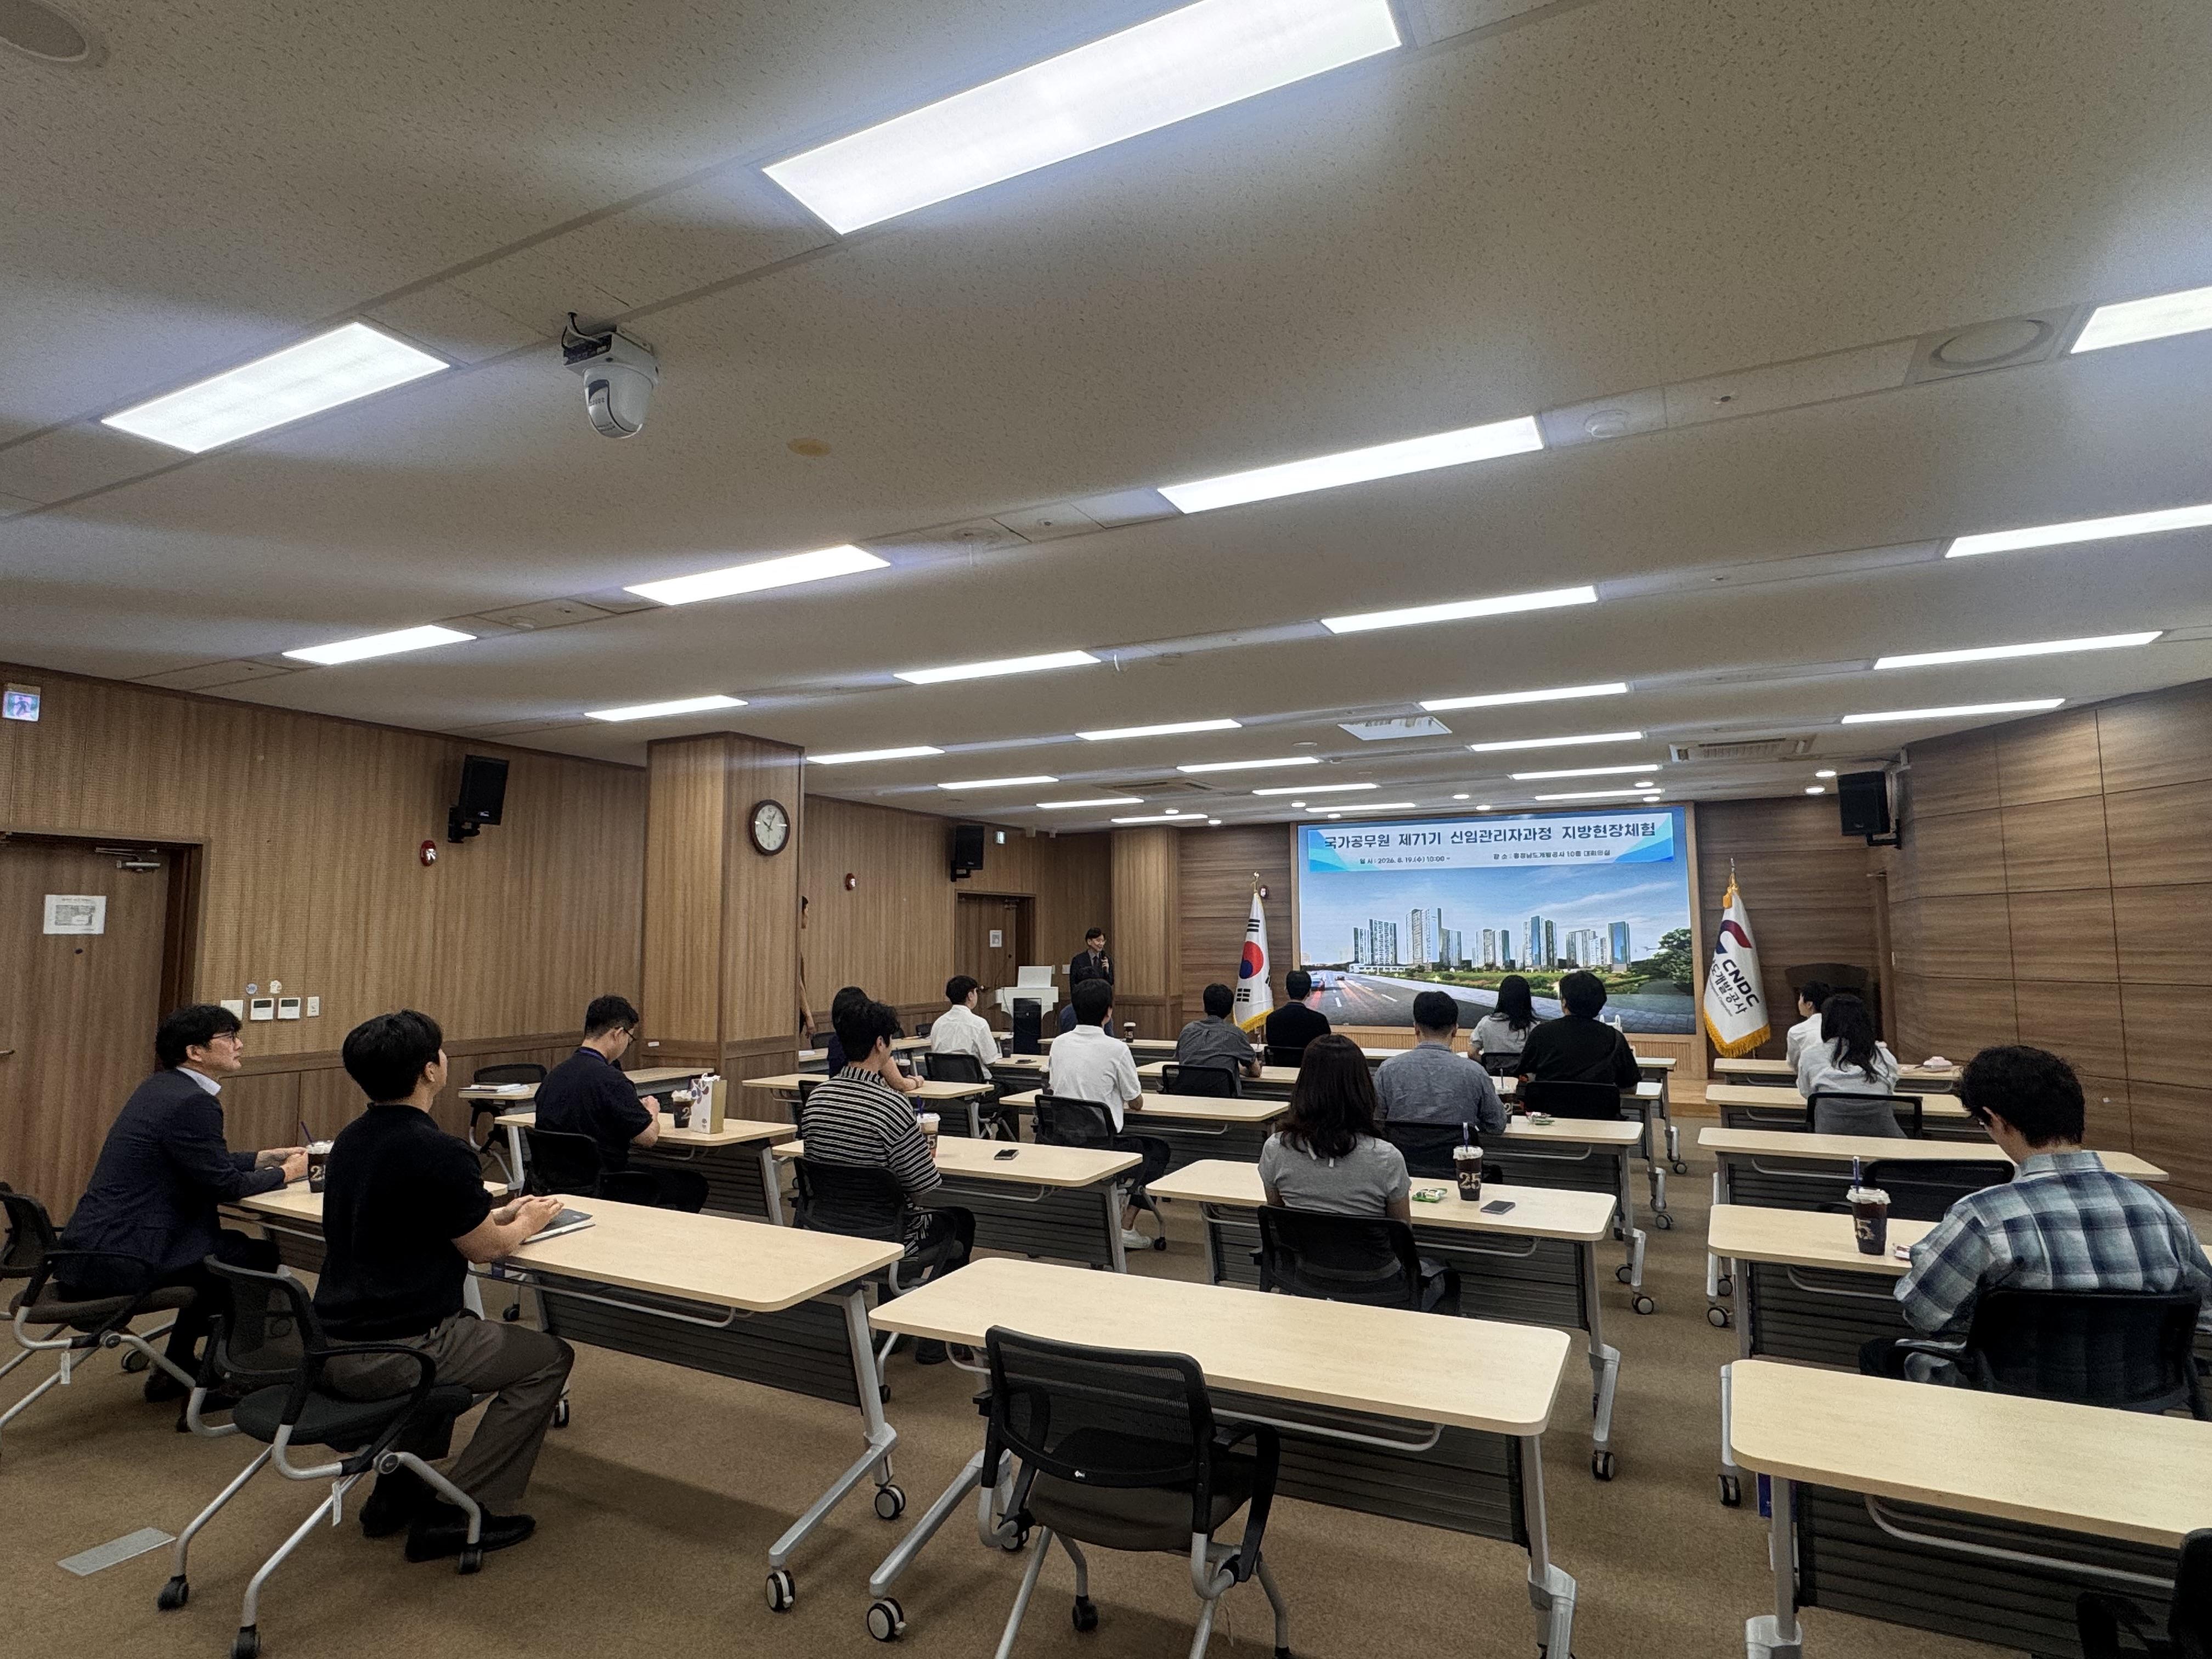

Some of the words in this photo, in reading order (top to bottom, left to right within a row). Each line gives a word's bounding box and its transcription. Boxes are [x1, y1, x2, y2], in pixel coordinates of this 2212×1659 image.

[1324, 834, 1390, 849] 국가공무원
[1398, 832, 1441, 846] 제71기
[1450, 827, 1552, 844] 신임관리자과정
[1562, 822, 1656, 839] 지방현장체험
[1711, 959, 1748, 1014] 도개발공사
[1722, 959, 1760, 1007] CNDC
[1459, 1172, 1481, 1189] 25
